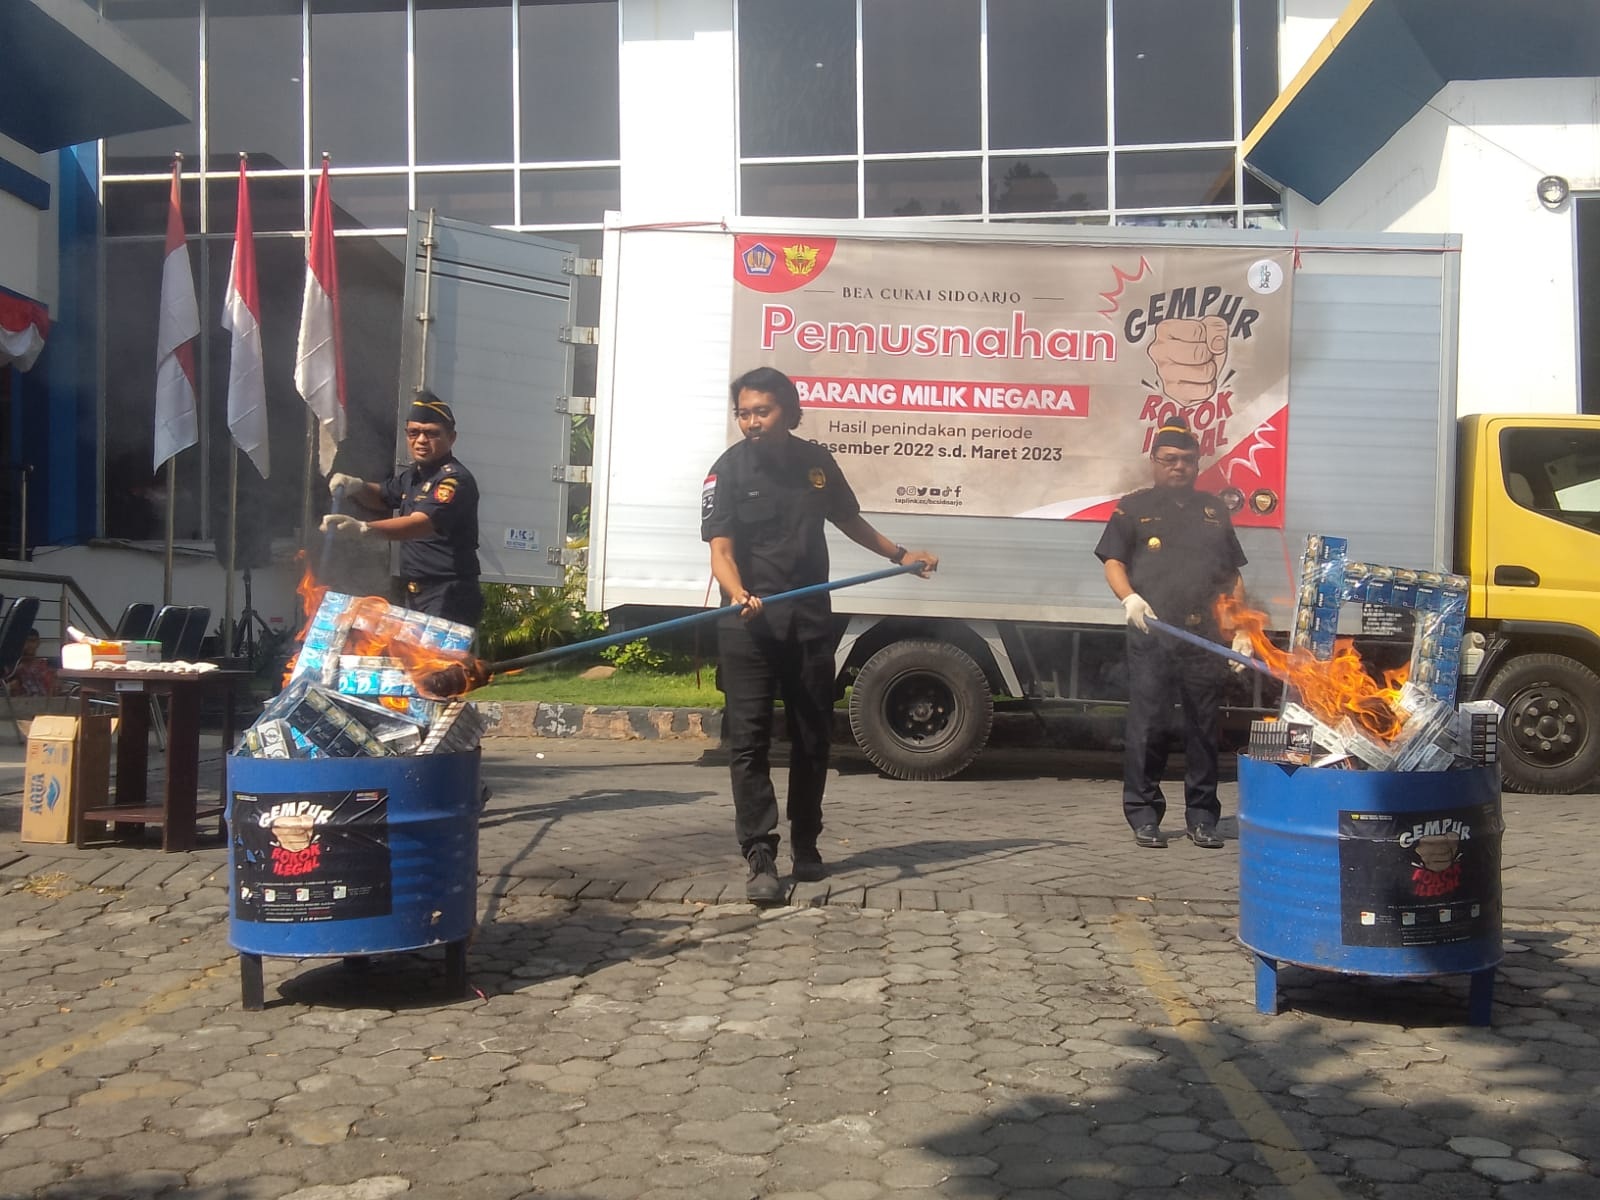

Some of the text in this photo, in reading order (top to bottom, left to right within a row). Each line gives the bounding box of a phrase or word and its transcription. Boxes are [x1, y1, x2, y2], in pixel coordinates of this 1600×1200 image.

[842, 287, 1021, 304] BEA CUKAI SIDOARJO
[1124, 285, 1260, 344] GEMPUR
[760, 303, 1118, 362] Pemusnahan
[795, 381, 1076, 411] BARANG MILIK NEGARA
[828, 419, 1033, 441] Hasil penindakan periode
[1141, 420, 1229, 457] IAL
[893, 441, 934, 457] 2022
[938, 443, 967, 459] s.d.
[970, 445, 1017, 461] Maret
[1021, 446, 1063, 462] 2023
[30, 772, 46, 816] AQUA
[258, 800, 334, 829] GEMPUR
[1400, 818, 1471, 848] GEMPUR
[271, 843, 321, 865] ROKOK
[272, 857, 321, 877] ILEGAL
